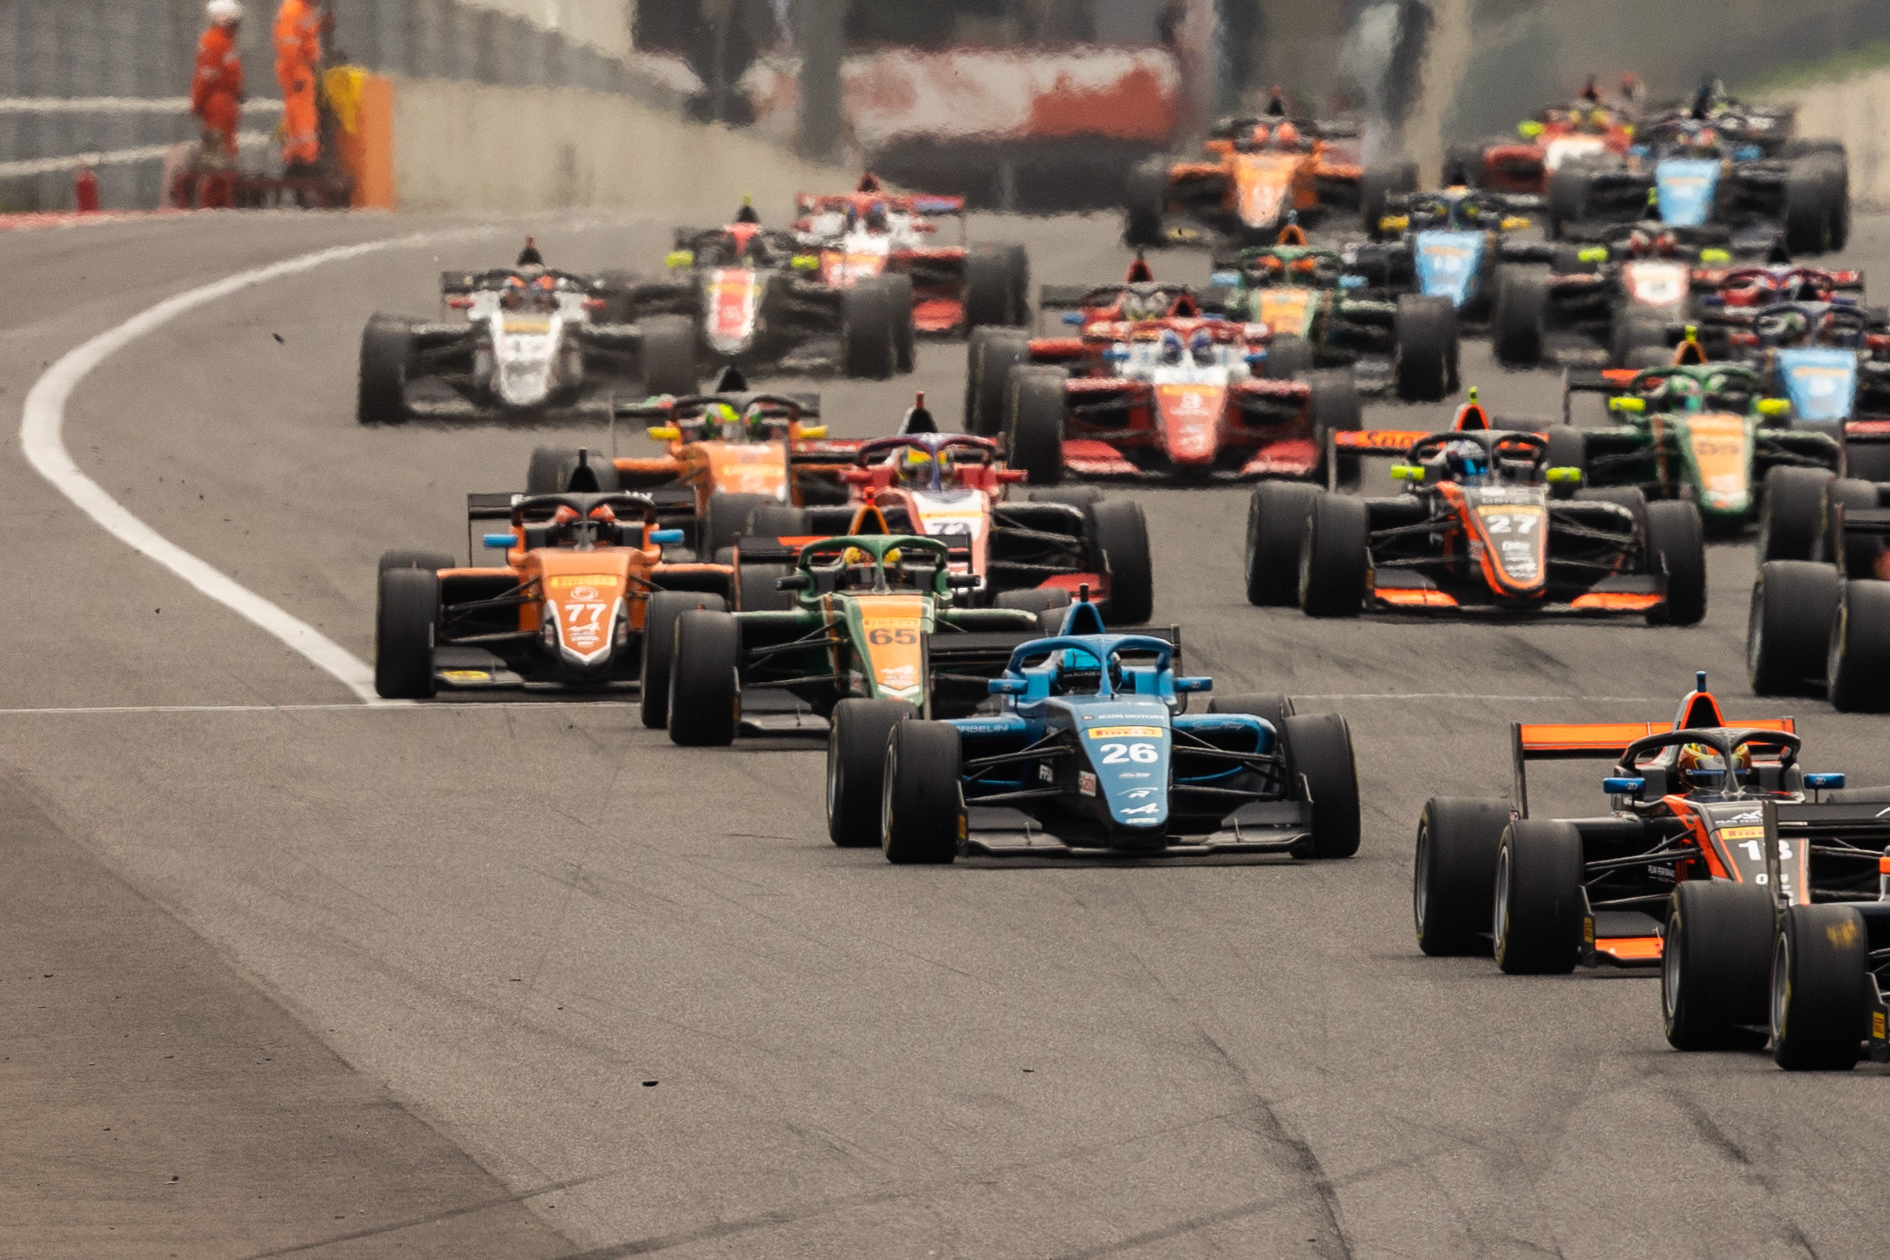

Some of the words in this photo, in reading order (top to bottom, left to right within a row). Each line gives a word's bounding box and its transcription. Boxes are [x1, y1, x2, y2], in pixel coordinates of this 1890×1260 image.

[1486, 513, 1538, 534] 27
[564, 603, 608, 622] 77
[869, 628, 918, 646] 65
[1100, 742, 1159, 764] 26
